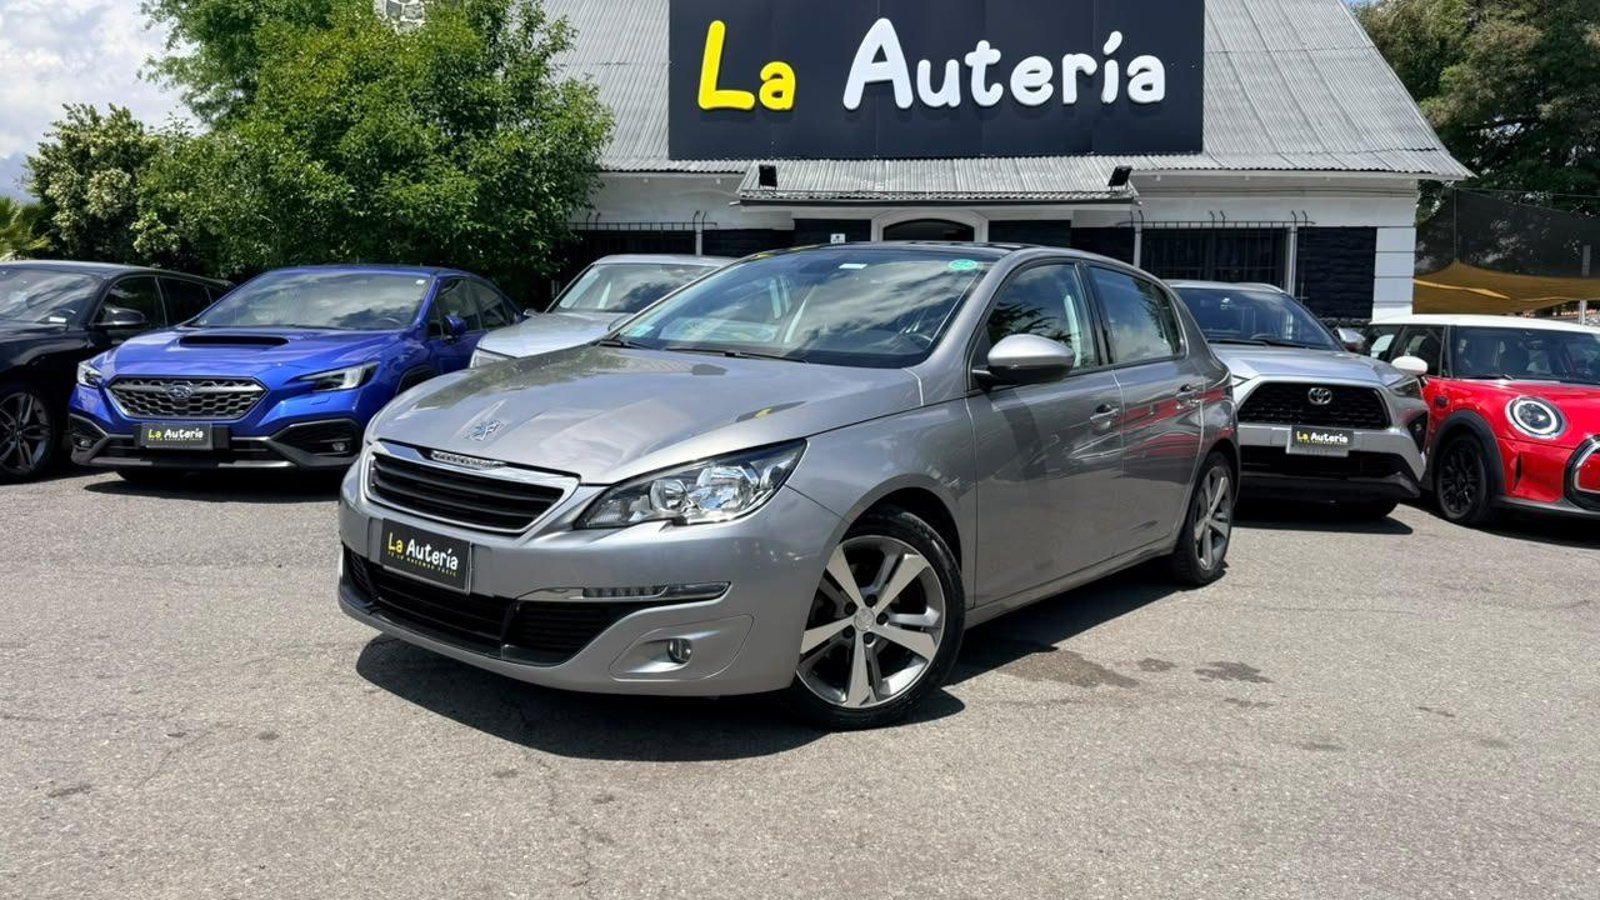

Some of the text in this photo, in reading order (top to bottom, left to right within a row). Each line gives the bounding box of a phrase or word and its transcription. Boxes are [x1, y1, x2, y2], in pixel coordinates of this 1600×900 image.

[698, 18, 1166, 111] La Autería
[148, 428, 161, 439] La
[1296, 431, 1309, 441] La
[388, 532, 404, 553] La
[406, 539, 459, 570] Autería
